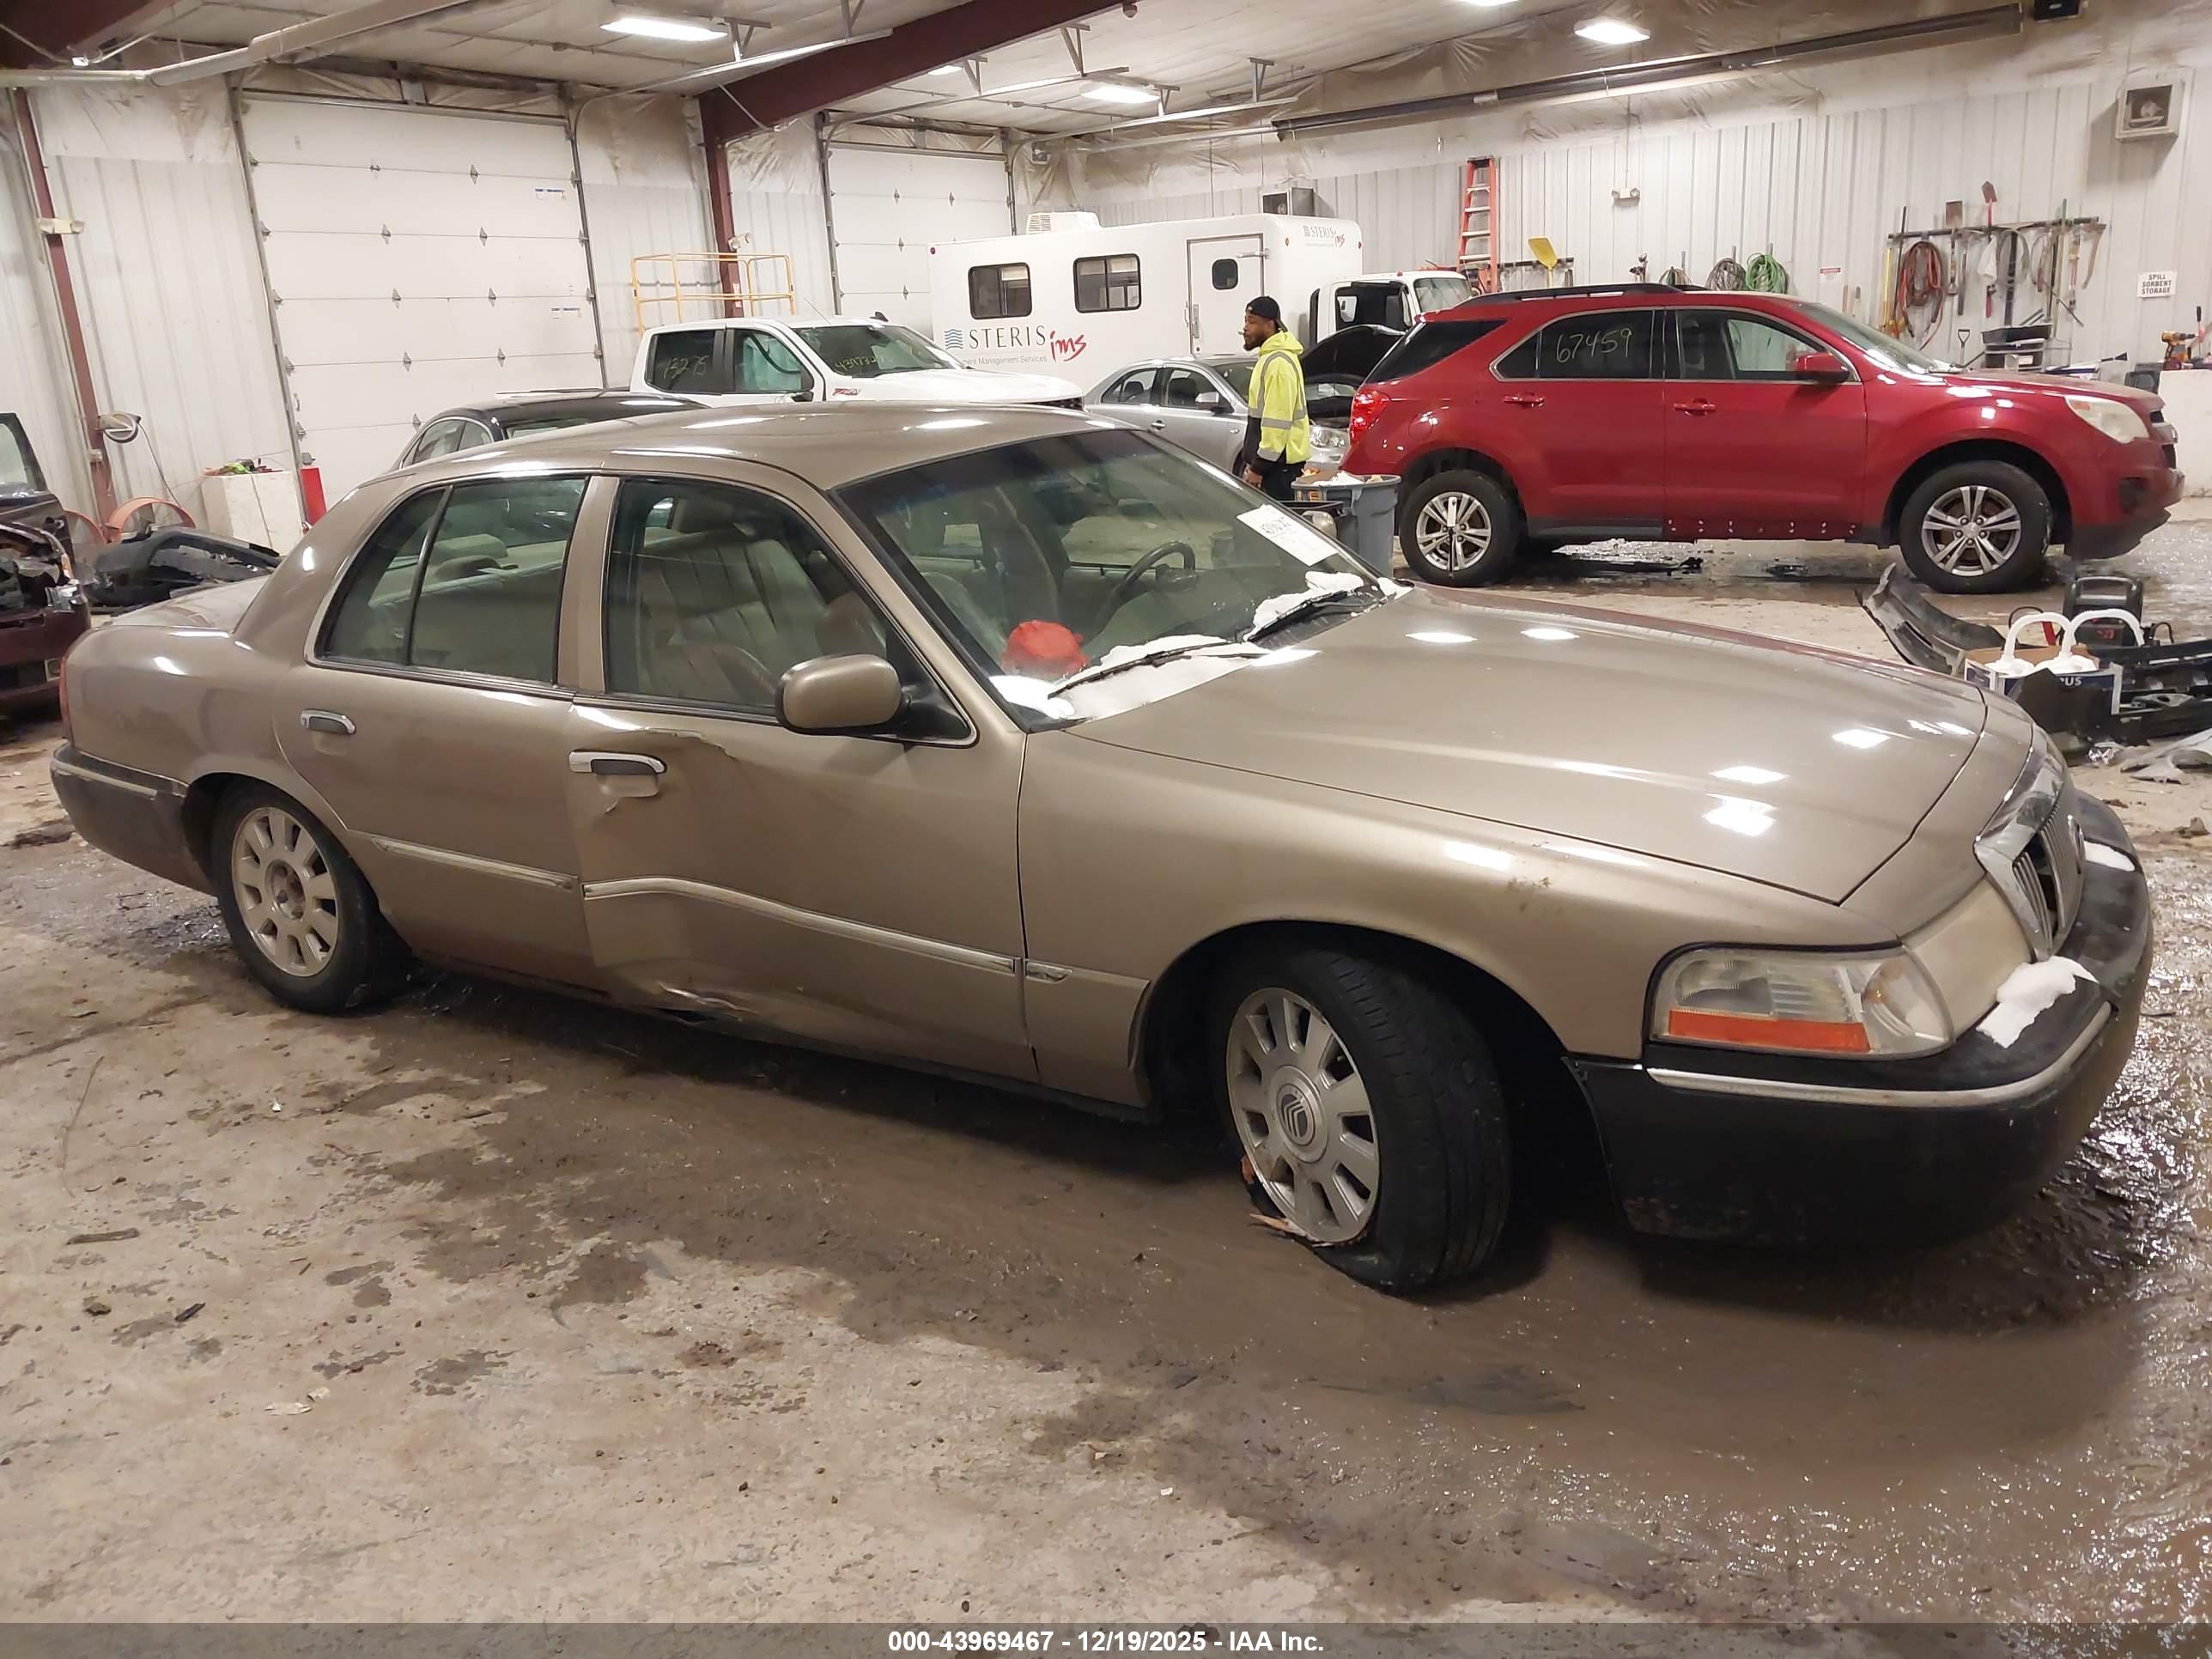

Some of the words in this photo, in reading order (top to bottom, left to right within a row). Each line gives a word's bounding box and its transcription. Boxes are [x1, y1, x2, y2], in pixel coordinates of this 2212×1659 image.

[1310, 226, 1334, 239] STERIS
[2142, 280, 2172, 289] SORBENT
[2142, 287, 2172, 295] STORAGE
[969, 325, 1046, 349] STERIS
[1049, 330, 1087, 362] ims
[1555, 327, 1632, 363] 67459
[978, 356, 1019, 366] Management
[1019, 355, 1048, 364] Services
[2060, 677, 2082, 686] US
